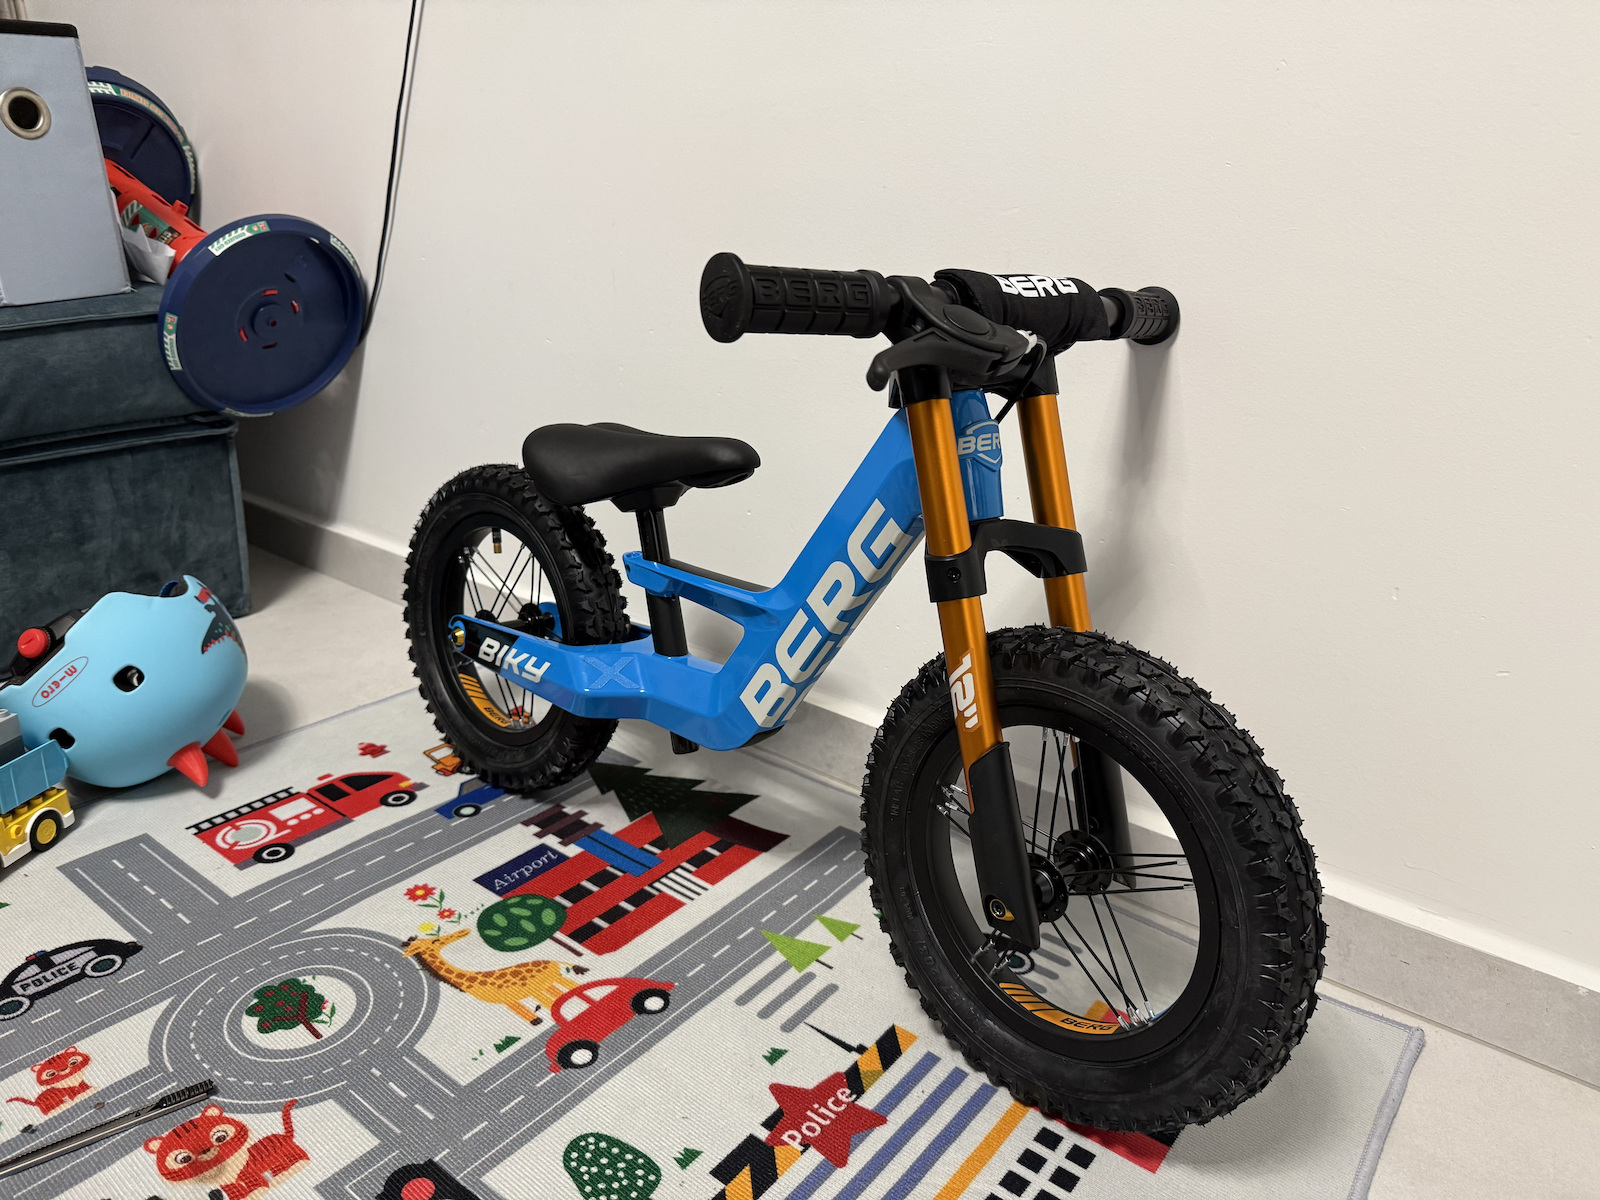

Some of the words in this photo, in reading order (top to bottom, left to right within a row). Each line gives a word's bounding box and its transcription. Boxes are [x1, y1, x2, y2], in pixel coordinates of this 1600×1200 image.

[755, 278, 869, 306] BERG
[993, 275, 1079, 298] BERG
[739, 498, 913, 728] BERG
[478, 636, 551, 684] BIKY
[494, 850, 558, 890] Airport
[20, 961, 80, 992] POLICE
[1061, 1017, 1117, 1031] BERG
[780, 1087, 857, 1152] Police
